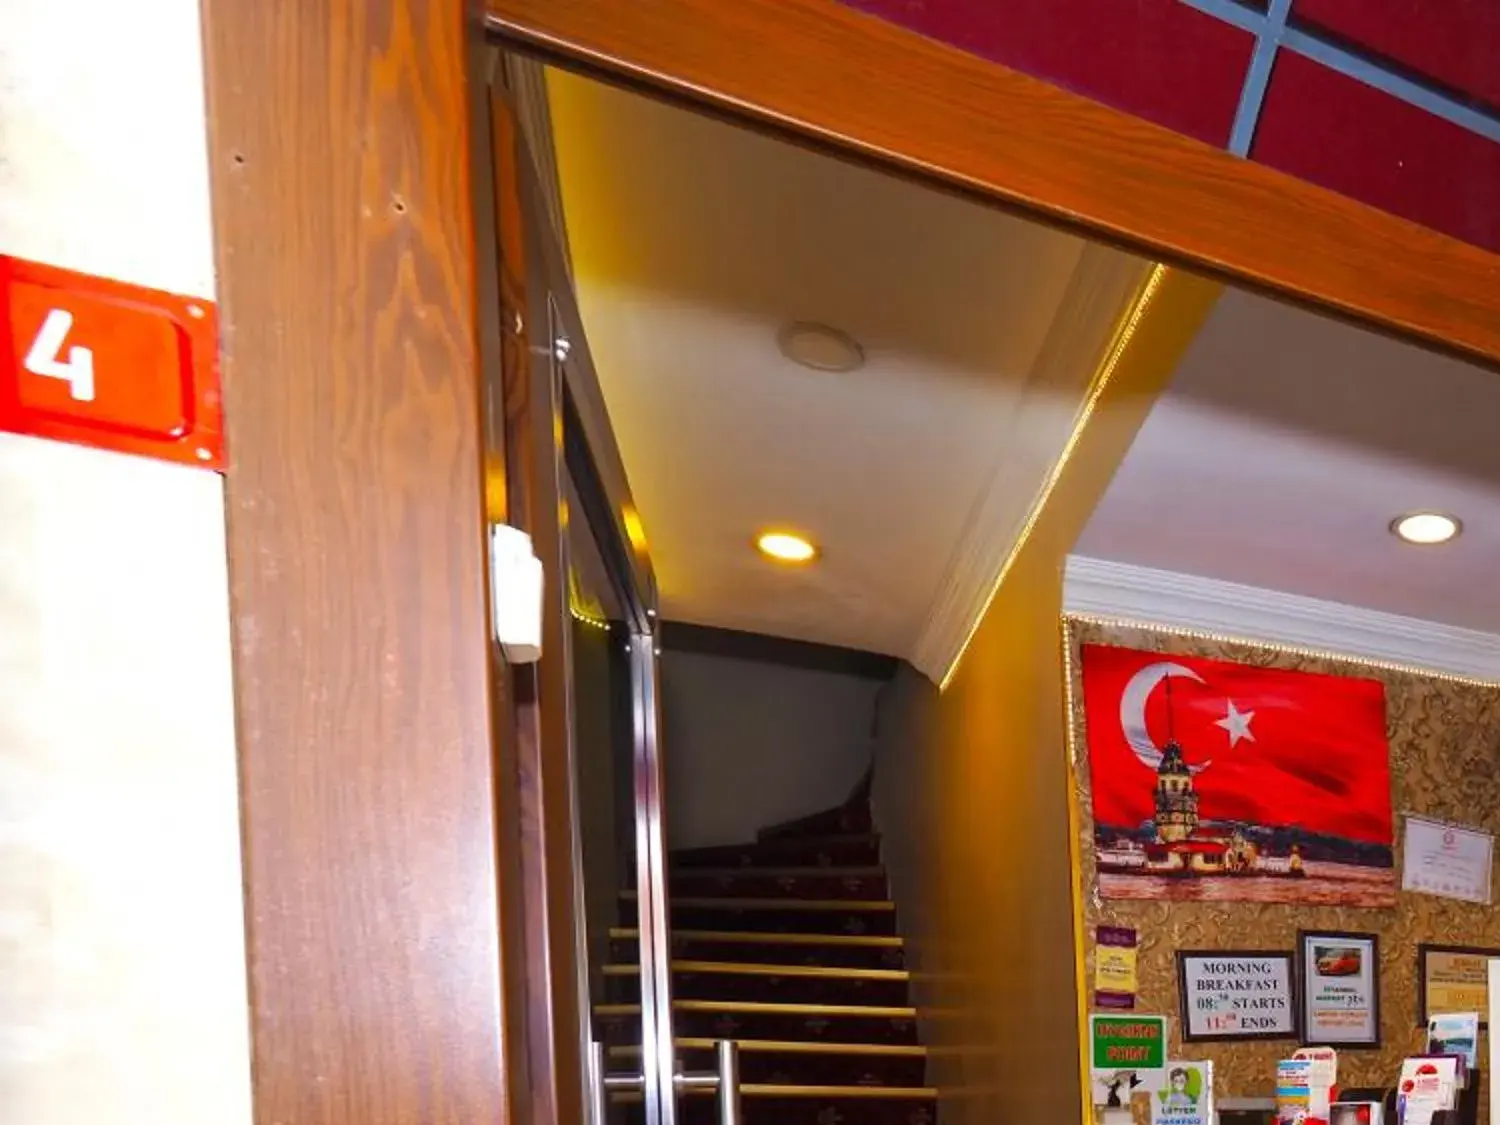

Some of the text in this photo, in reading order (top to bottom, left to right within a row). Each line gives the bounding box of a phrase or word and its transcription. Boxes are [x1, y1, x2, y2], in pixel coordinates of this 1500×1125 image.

[24, 308, 95, 402] 4
[1203, 962, 1272, 974] MORNING
[1196, 979, 1278, 991] BREAKFAST
[1232, 998, 1285, 1010] STARTS
[1241, 1017, 1277, 1028] ENDS
